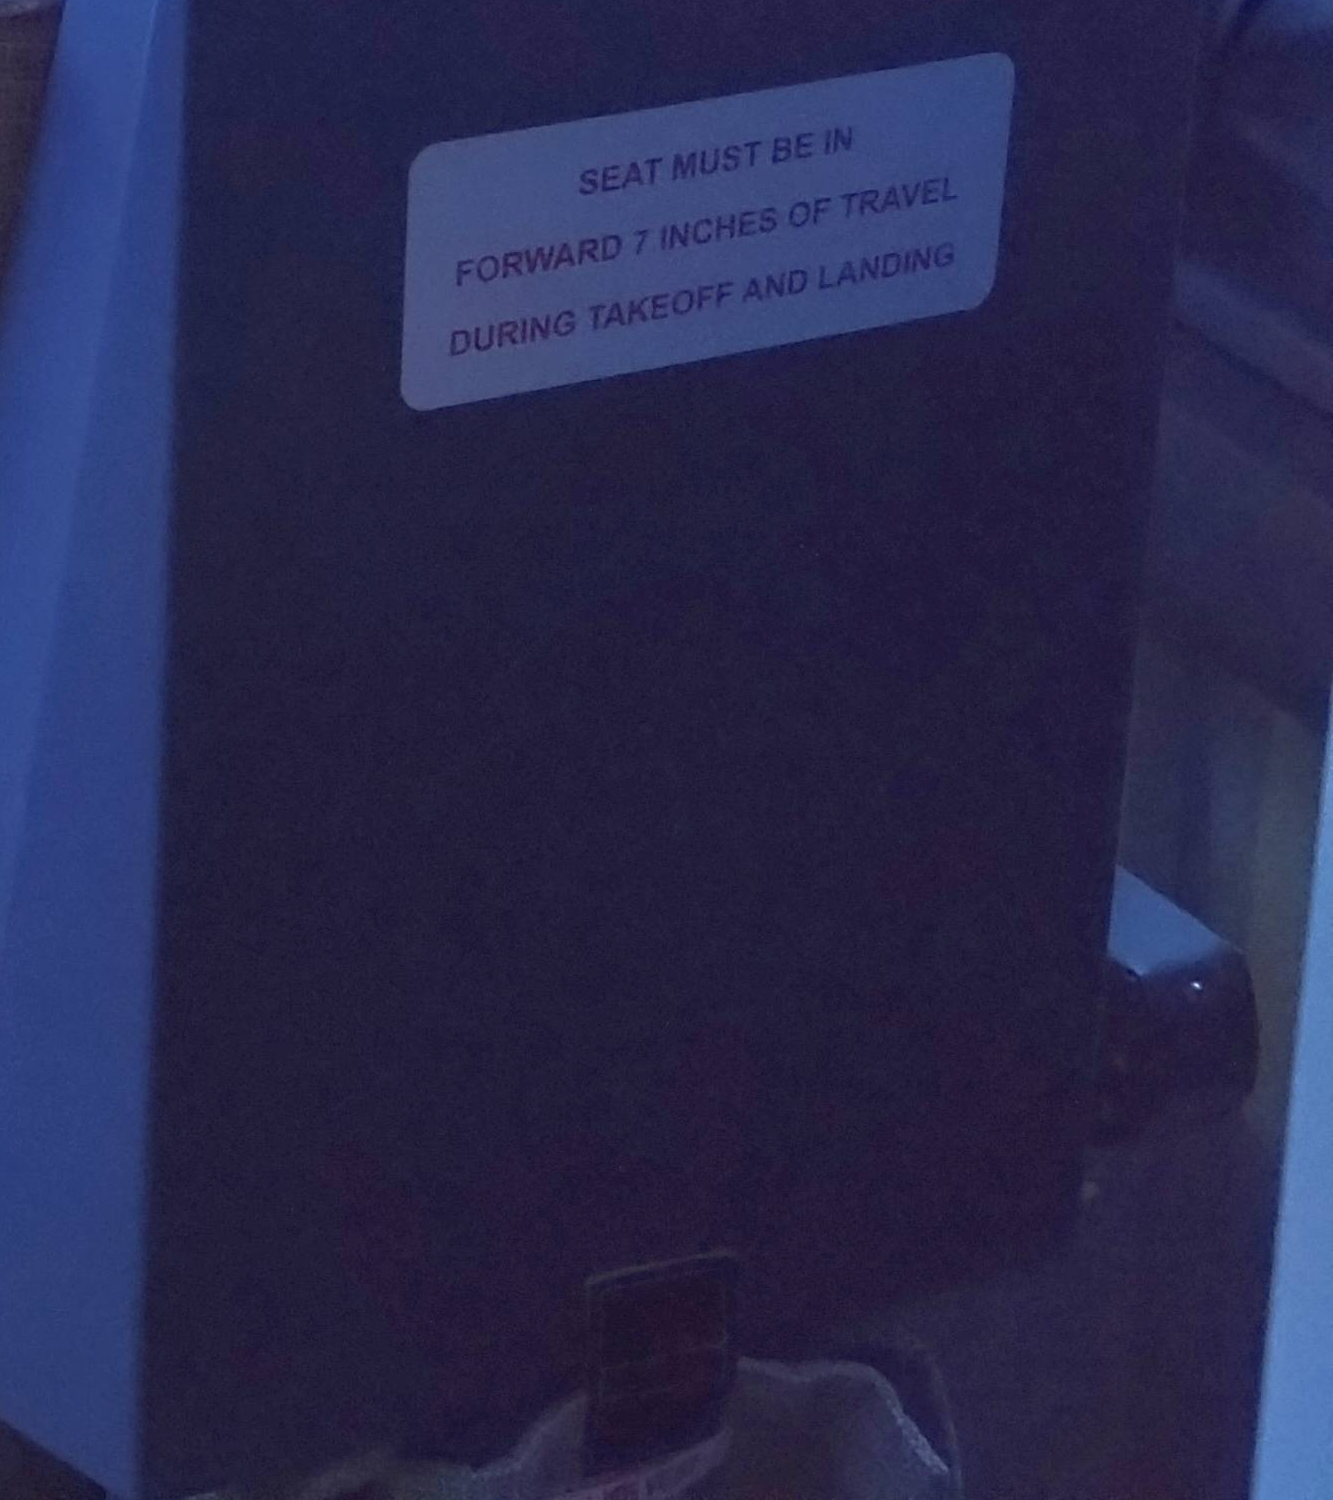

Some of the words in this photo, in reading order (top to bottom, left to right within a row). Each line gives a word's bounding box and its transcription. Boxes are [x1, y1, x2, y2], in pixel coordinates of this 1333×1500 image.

[579, 157, 661, 195] SEAT
[673, 142, 759, 180] MUST
[772, 133, 815, 164] BE
[824, 126, 853, 154] IN
[456, 234, 623, 286] FORWARD
[633, 230, 649, 255] 7
[660, 209, 777, 250] INCHES
[788, 198, 831, 229] OF
[841, 177, 957, 220] TRAVEL
[449, 310, 576, 356] DURING
[590, 282, 733, 328] TAKEOFF
[741, 268, 808, 302] AND
[818, 243, 955, 290] LANDING
